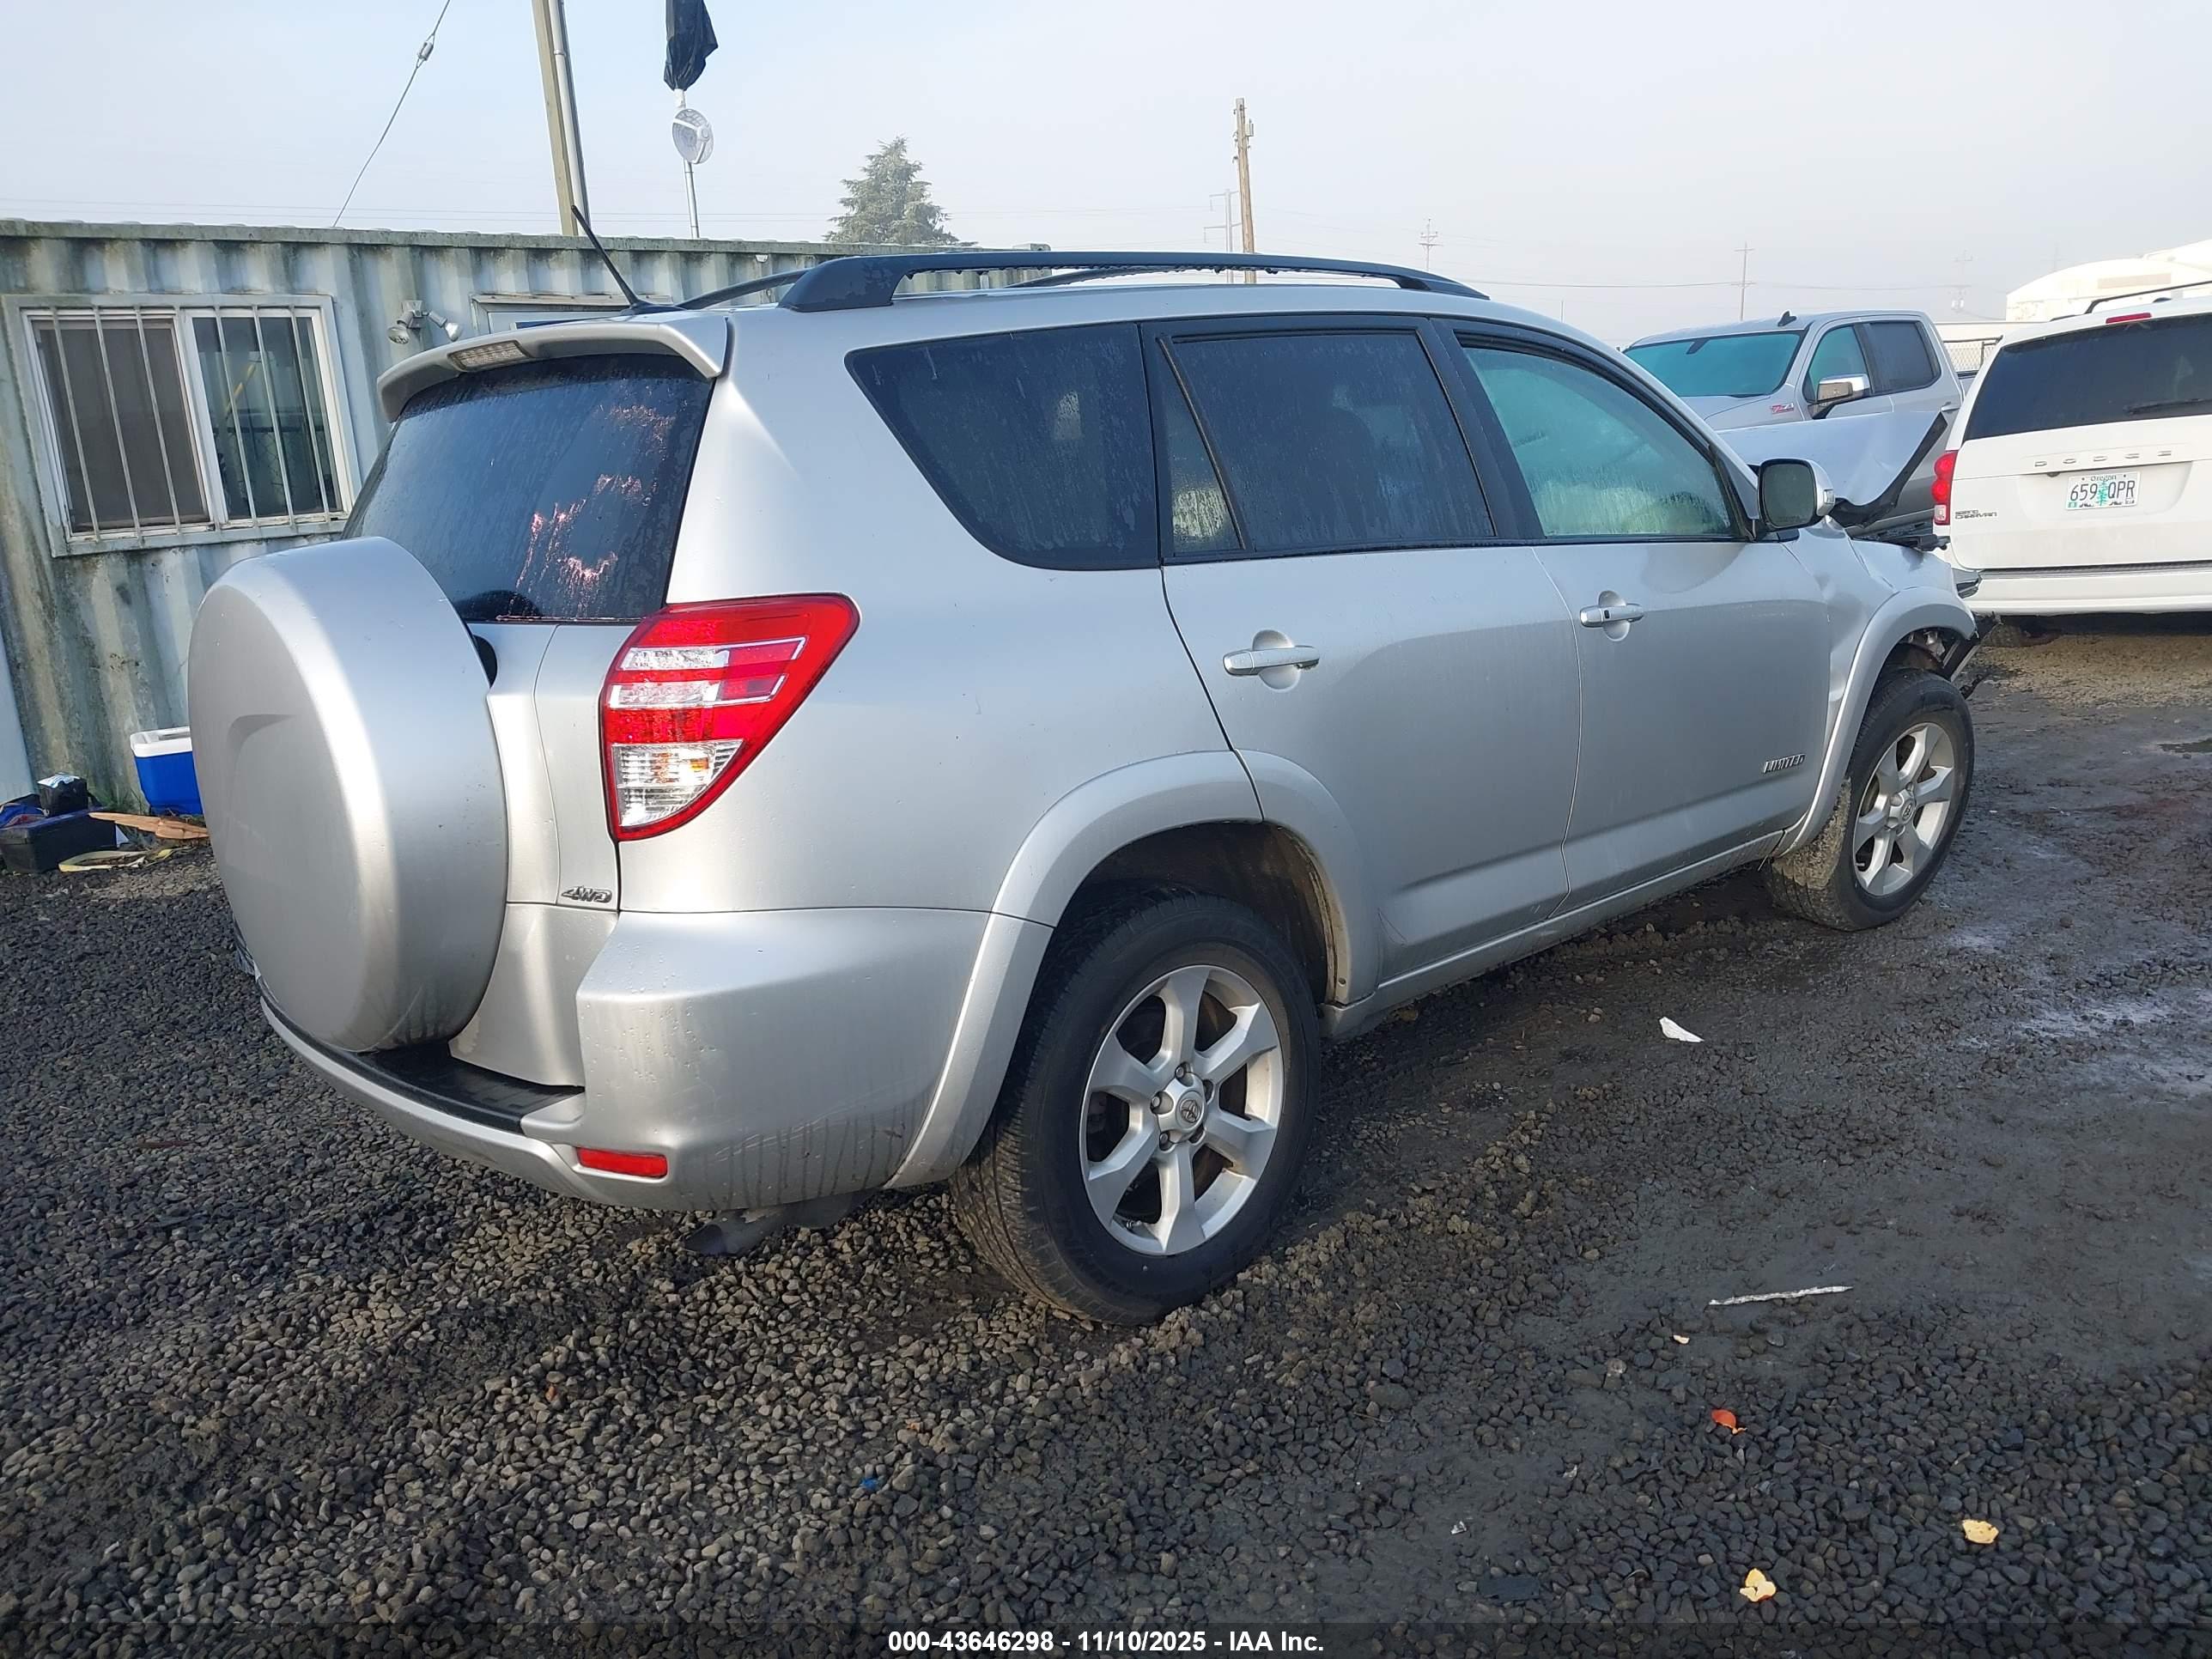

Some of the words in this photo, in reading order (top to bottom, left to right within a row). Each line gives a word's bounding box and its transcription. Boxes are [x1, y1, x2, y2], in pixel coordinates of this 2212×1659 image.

[2034, 450, 2172, 468] DODGE
[2069, 483, 2098, 501] 659
[2107, 480, 2136, 499] QPR
[1763, 753, 1806, 774] LIMITED
[561, 885, 612, 903] 4WD
